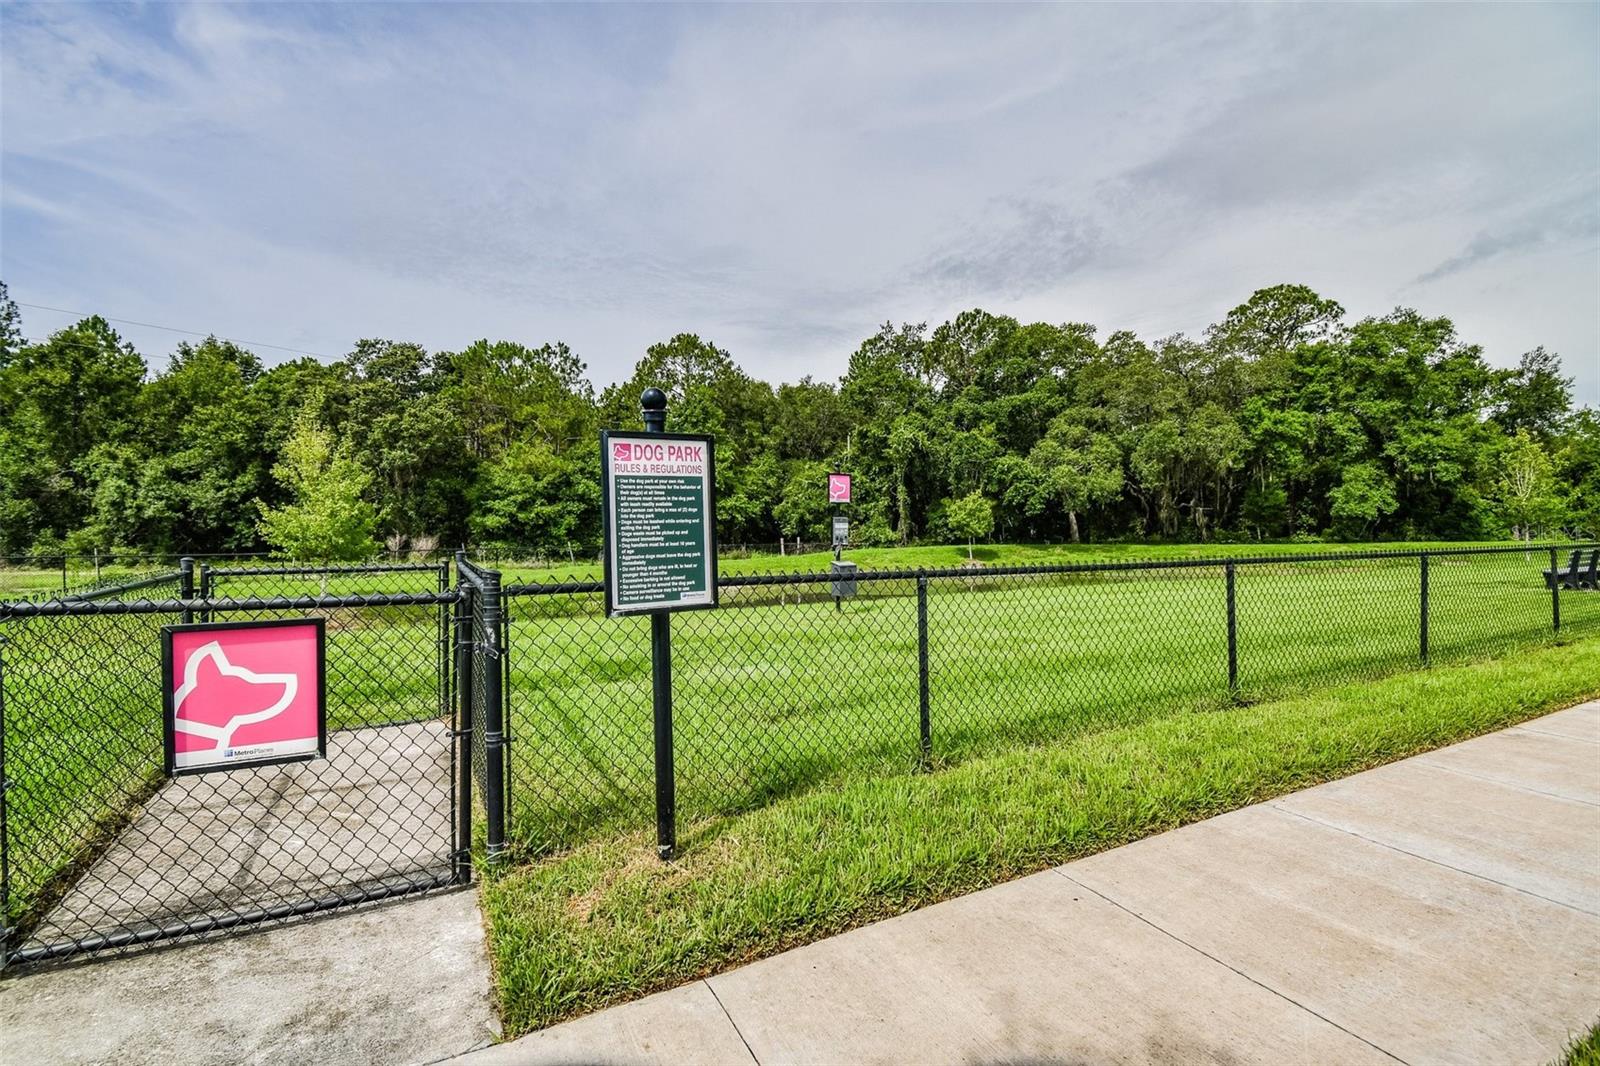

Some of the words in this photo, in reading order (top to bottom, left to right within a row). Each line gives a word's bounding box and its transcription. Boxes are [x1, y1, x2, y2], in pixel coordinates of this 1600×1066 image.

[634, 444, 663, 461] DOG
[668, 446, 702, 462] PARK
[615, 464, 640, 472] RULES
[650, 464, 702, 474] REGULATIONS
